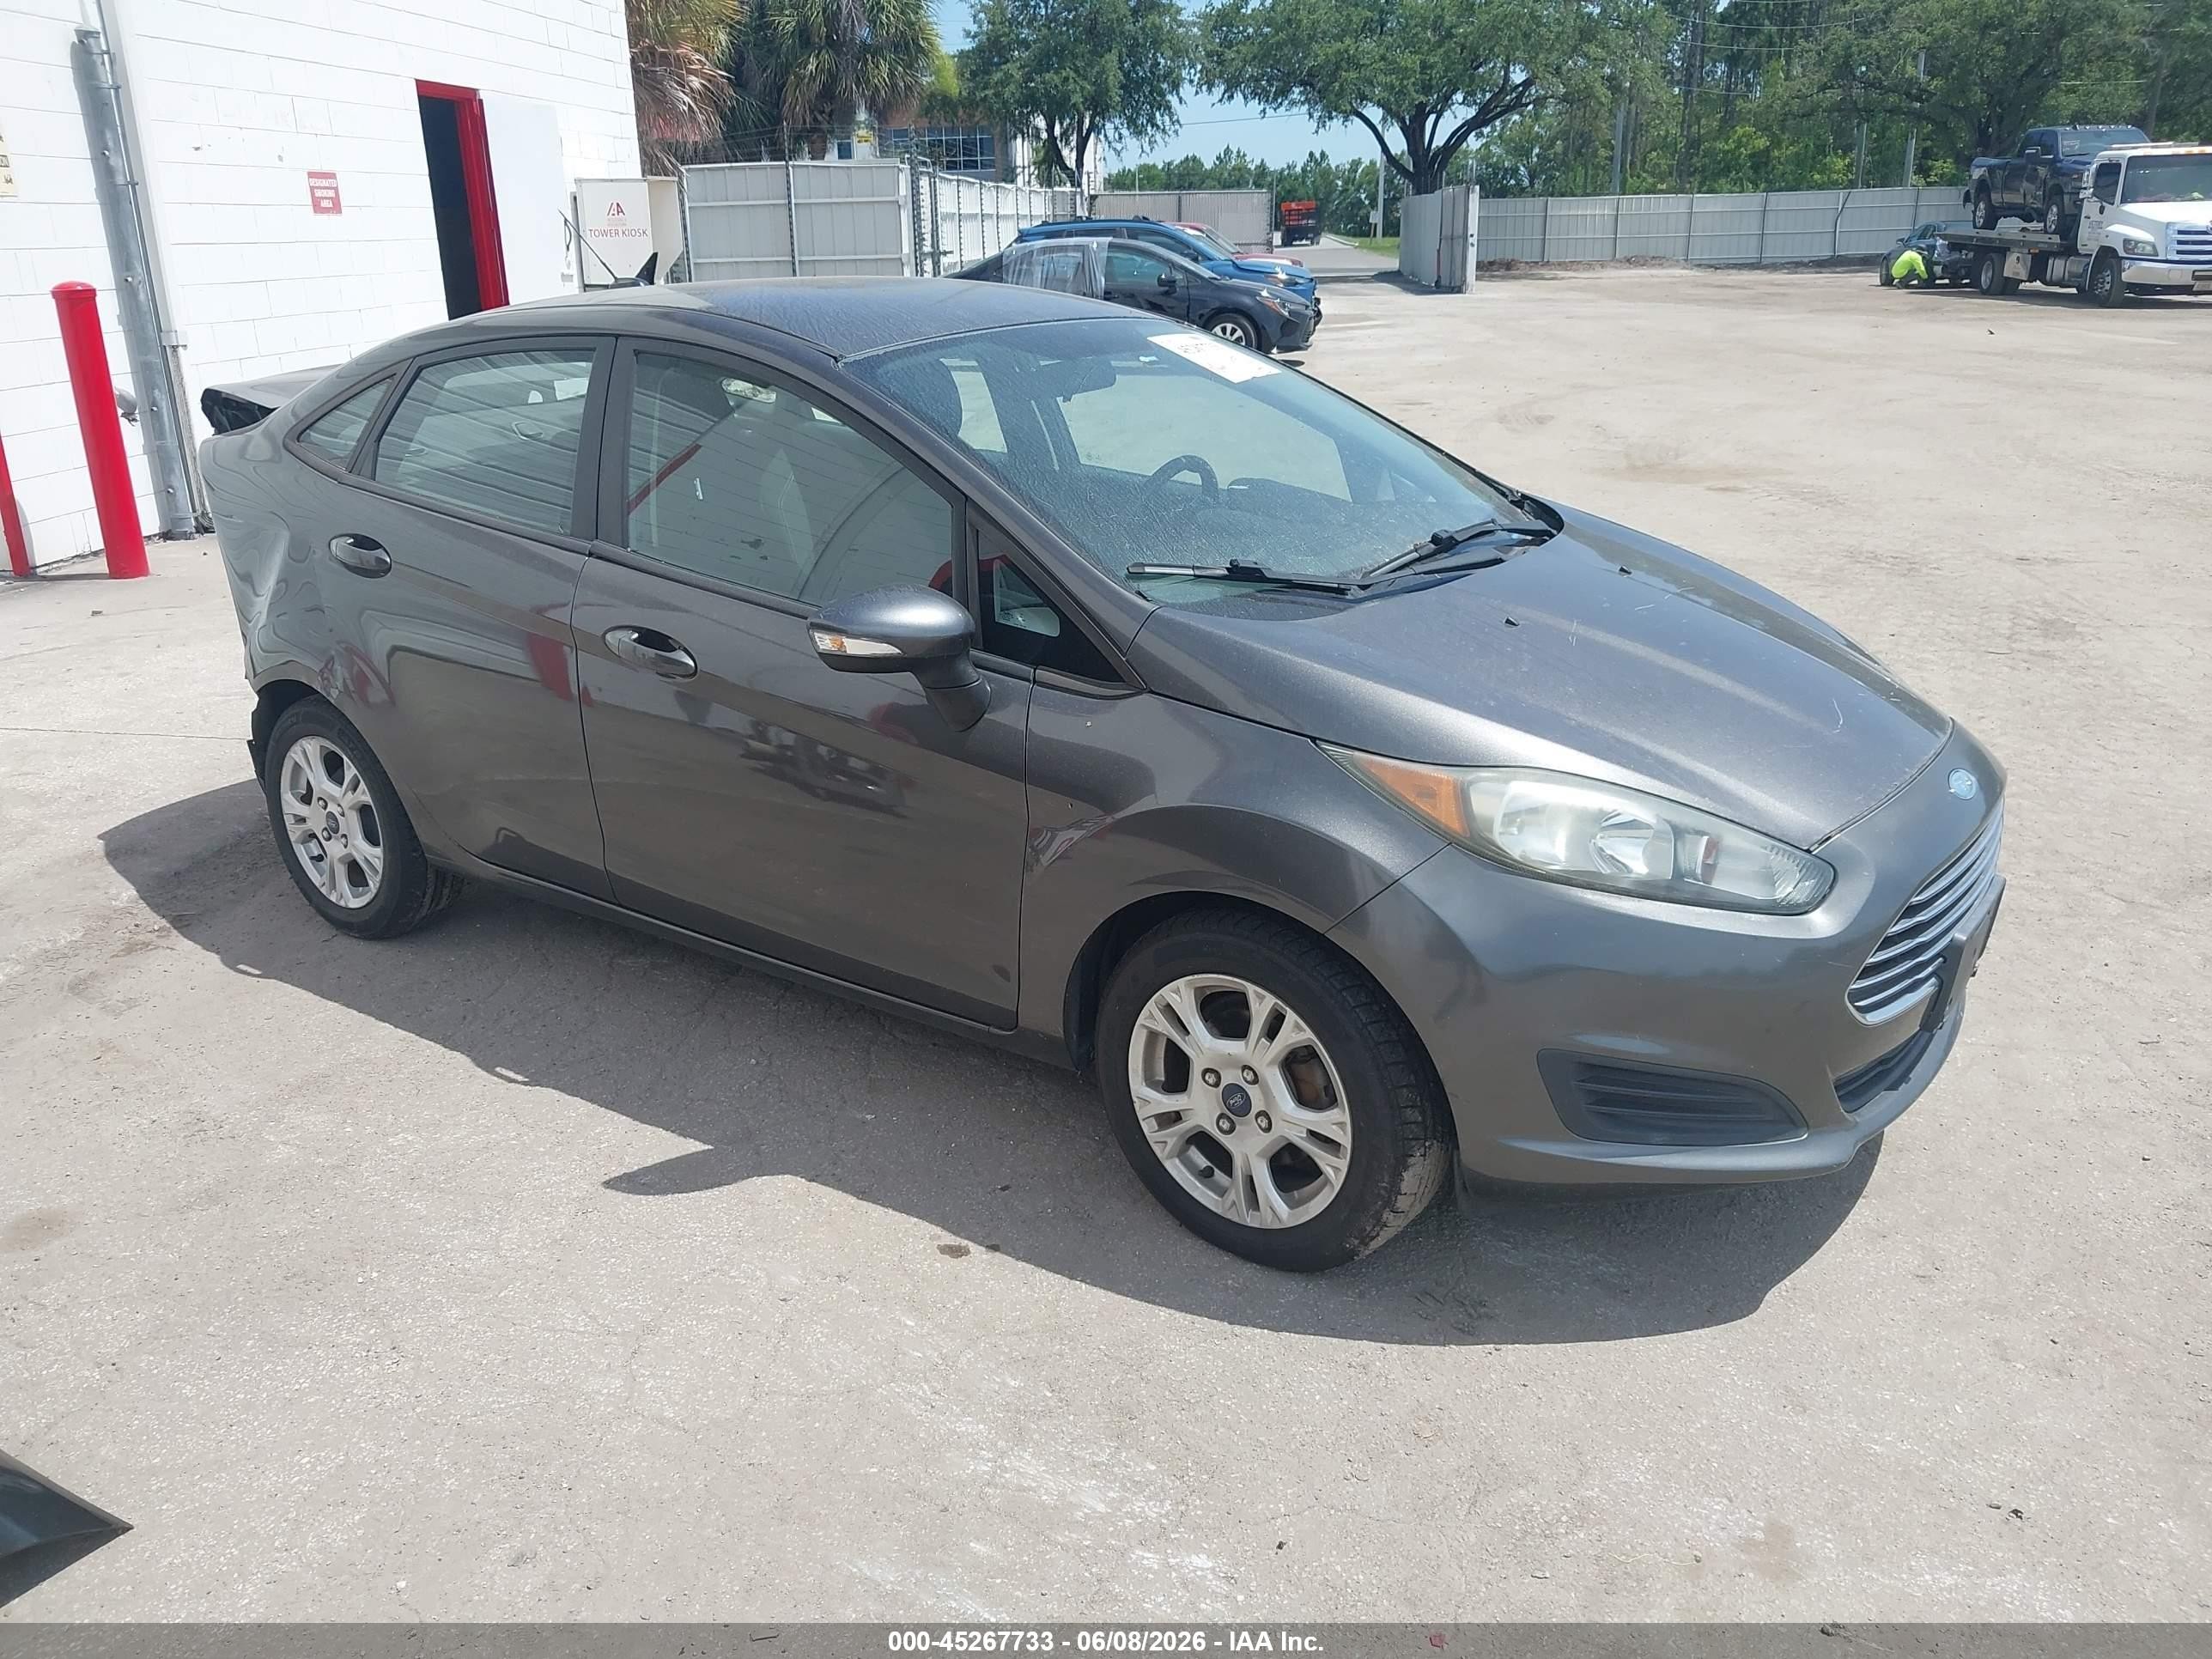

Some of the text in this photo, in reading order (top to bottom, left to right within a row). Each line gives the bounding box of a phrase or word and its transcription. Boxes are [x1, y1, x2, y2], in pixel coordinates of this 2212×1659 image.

[309, 178, 337, 187] DESIGNATED
[320, 198, 334, 207] AREA
[589, 228, 648, 238] TOWER KIOSK
